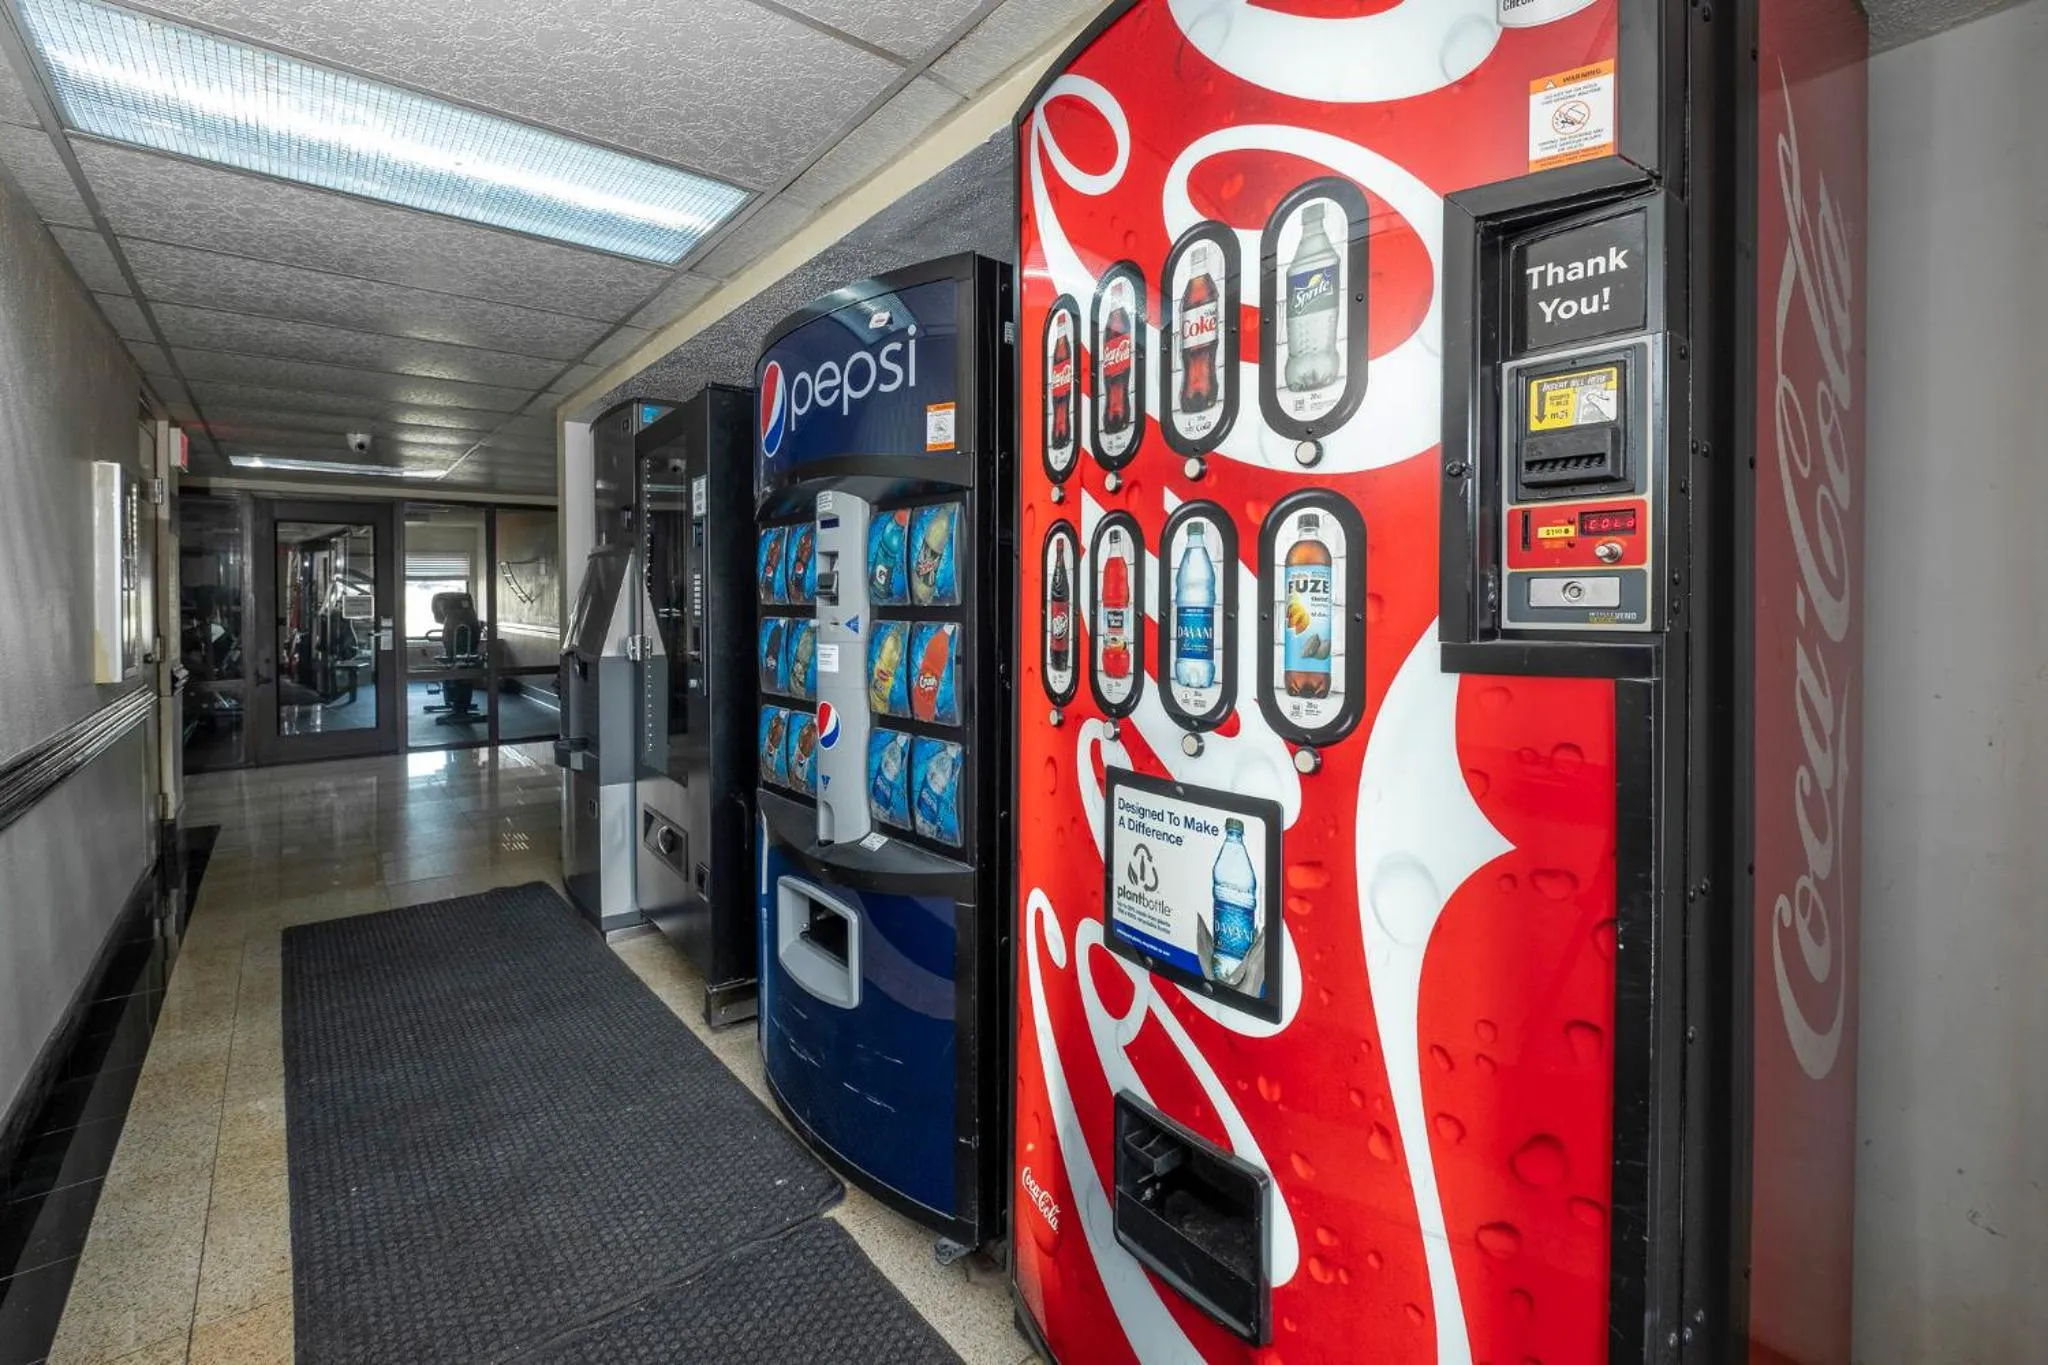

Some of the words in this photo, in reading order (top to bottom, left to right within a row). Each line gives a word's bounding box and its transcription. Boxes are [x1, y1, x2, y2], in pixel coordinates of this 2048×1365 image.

[1525, 246, 1630, 292] Thank
[1293, 280, 1331, 309] Sprite
[1538, 288, 1611, 324] You!
[1182, 315, 1216, 339] Coke
[791, 324, 916, 432] pepsi
[1773, 55, 1855, 1081] Coca-Cola
[1288, 579, 1330, 594] FUZE
[1117, 797, 1164, 822] Designed
[1167, 811, 1181, 827] To
[1184, 816, 1219, 836] Make
[1118, 816, 1126, 829] A
[1127, 818, 1184, 846] Difference
[1117, 884, 1172, 917] plantbottle
[1022, 1166, 1061, 1232] Coca-Cola
